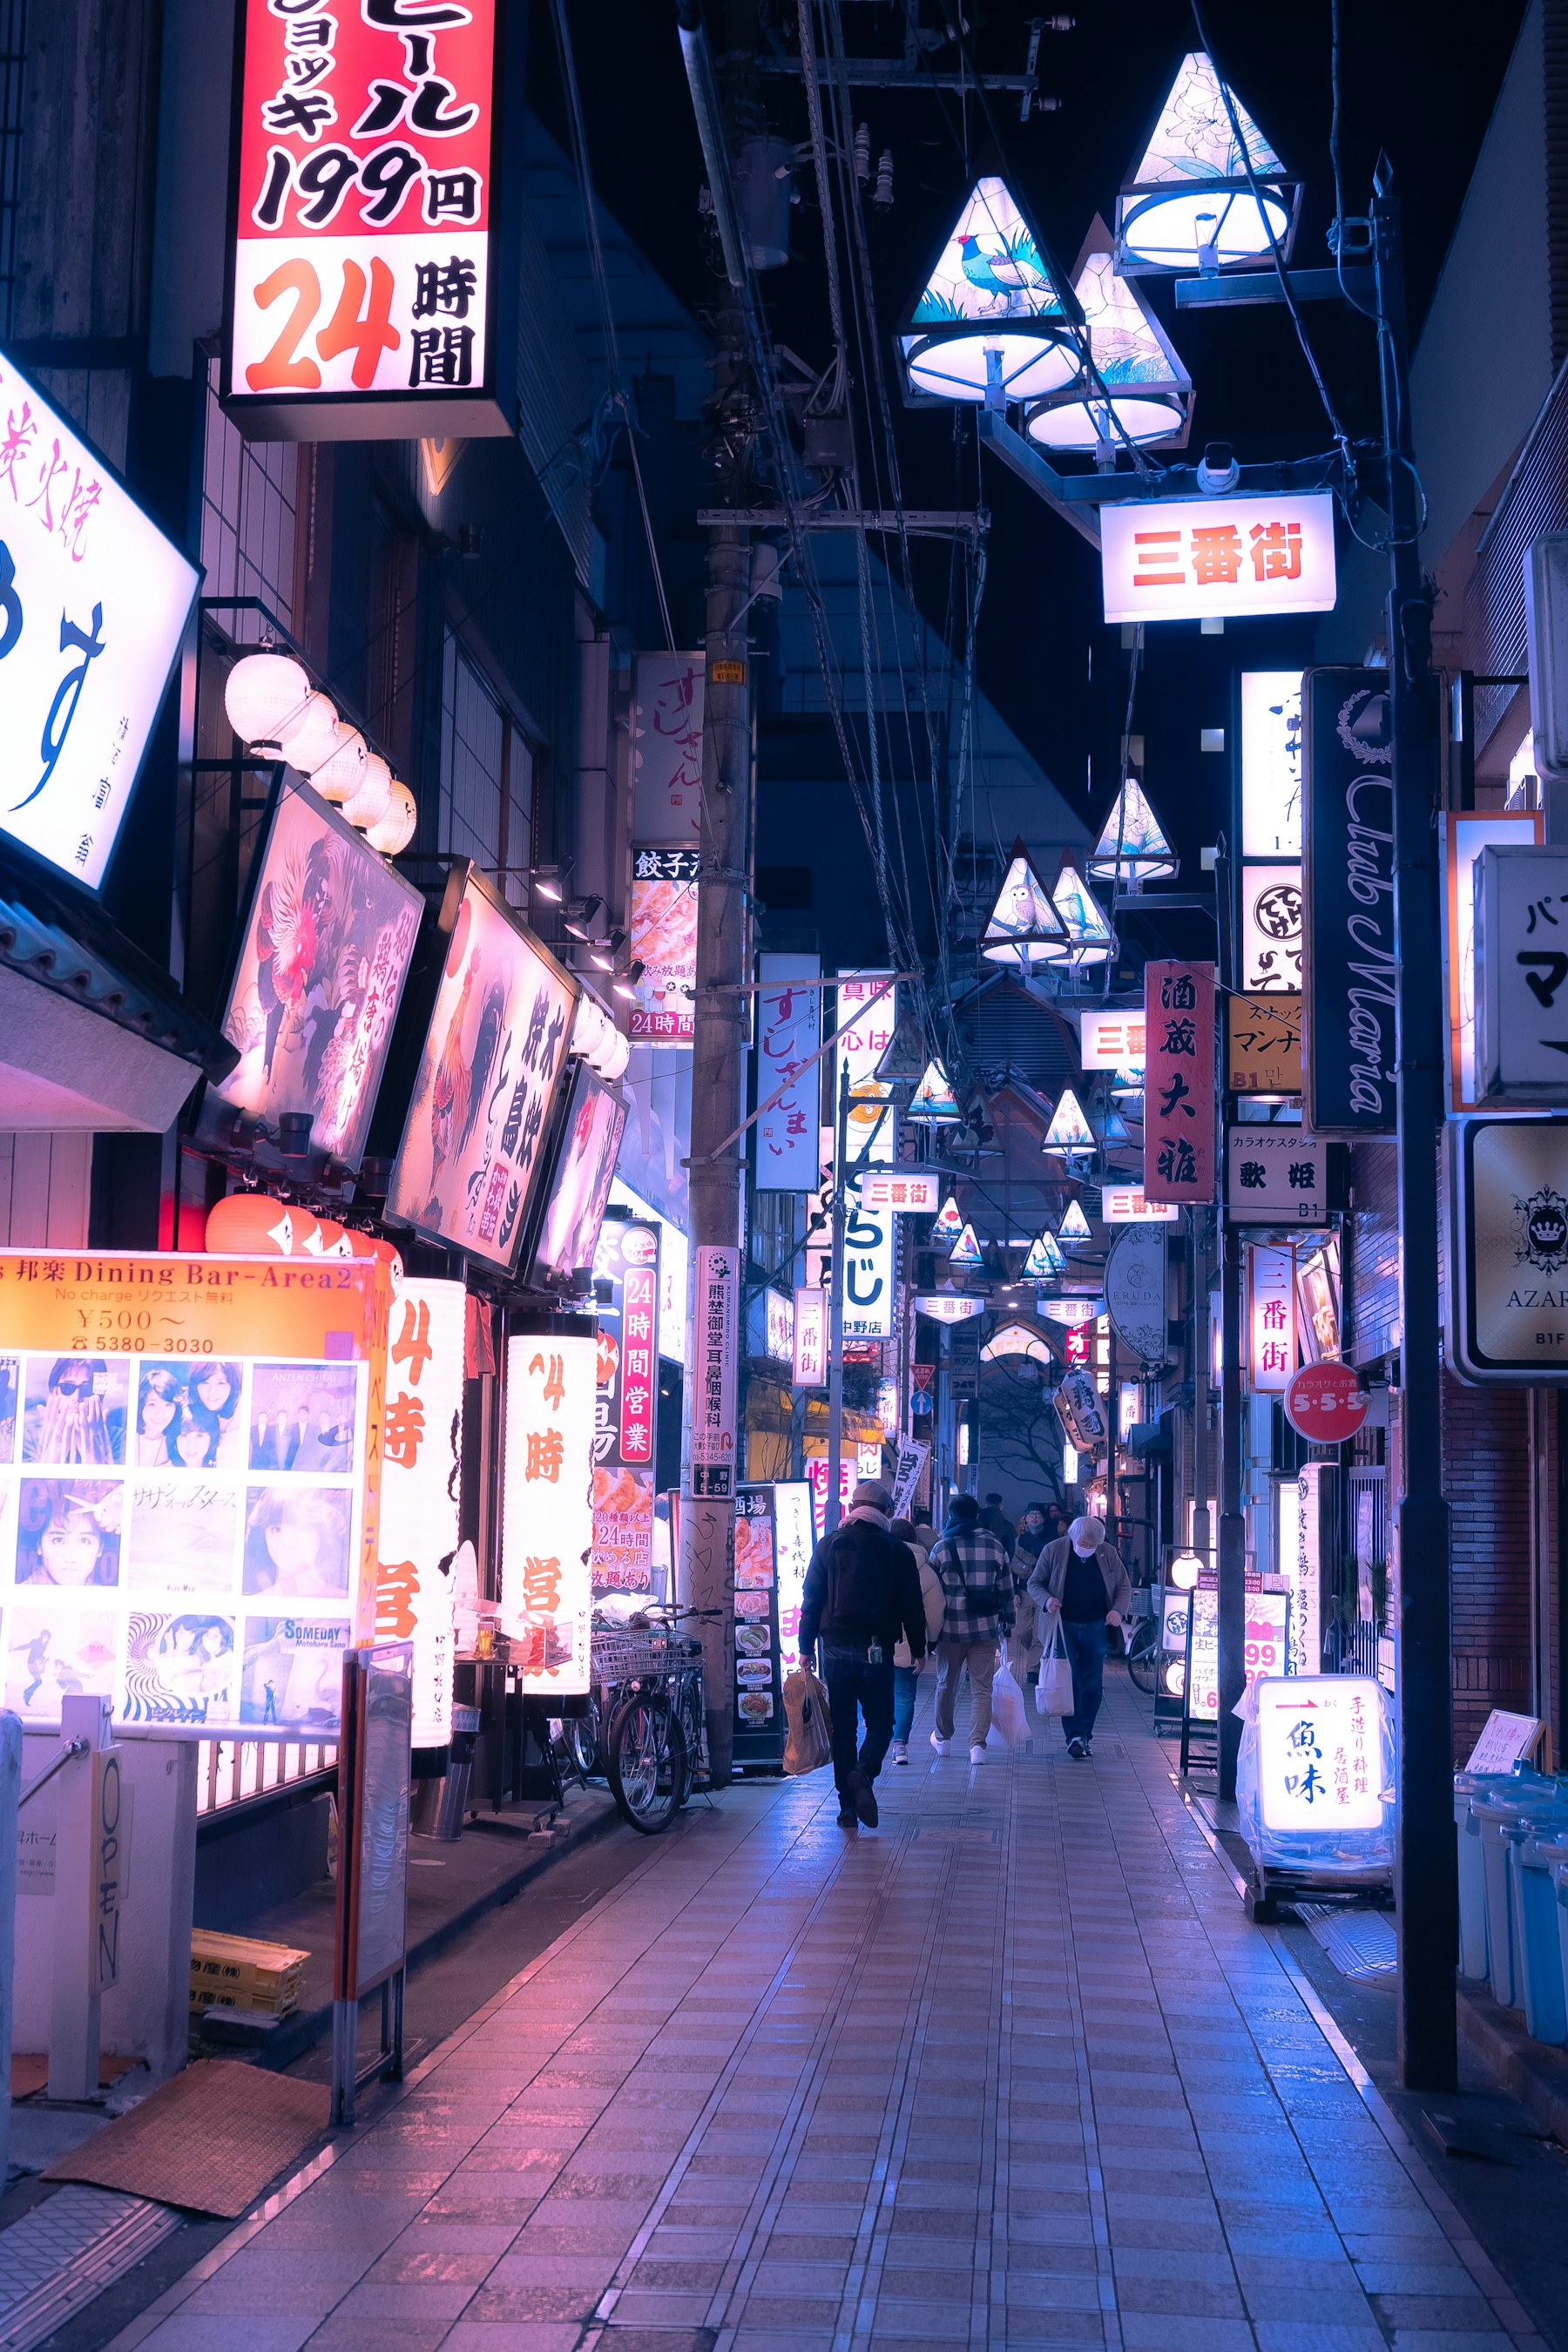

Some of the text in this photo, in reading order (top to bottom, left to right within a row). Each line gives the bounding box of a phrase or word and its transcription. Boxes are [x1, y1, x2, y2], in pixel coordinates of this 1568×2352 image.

[267, 0, 333, 137] ョッキ
[259, 146, 477, 225] 199円
[246, 256, 477, 392] 24 時間
[1133, 522, 1303, 587] 三番街
[1345, 775, 1394, 906] Club
[1526, 895, 1568, 933] パ
[1348, 914, 1396, 1115] Maria
[1233, 1031, 1301, 1053] マンナ
[762, 988, 808, 1156] すしざんまい
[1157, 976, 1199, 1186] 酒蔵大雅
[1233, 1071, 1259, 1088] B1
[1240, 1161, 1316, 1190] 歌姫
[871, 1183, 928, 1204] 三番街
[1299, 1203, 1318, 1217] B1
[17, 1260, 352, 1289] 邦楽 Dining Bar-Area2
[56, 1288, 234, 1305] No charge リクエスト無料
[927, 1300, 972, 1315] 三番街
[1049, 1303, 1094, 1317] 三番街
[1113, 1291, 1161, 1300] ERUDA
[1259, 1260, 1288, 1373] 三番街
[96, 1336, 214, 1353] 5380-3030
[801, 1301, 819, 1373] 三番街
[1536, 1333, 1565, 1344] B1F
[624, 1278, 652, 1452] 24時間営業
[704, 1284, 725, 1428] 熊埜御堂 耳鼻咽喉科
[272, 1373, 304, 1382] ANZEN
[1297, 1379, 1356, 1389] カラオケとお酒
[693, 1432, 720, 1442] この手前
[700, 1471, 728, 1482] 中野
[700, 1483, 728, 1492] 5-59
[592, 1512, 650, 1524] 120種類以上
[599, 1526, 649, 1547] 24時間
[285, 1619, 341, 1640] SOMEDAY
[1349, 1696, 1369, 1794] 手造り料理
[1284, 1720, 1327, 1804] 魚味
[1334, 1747, 1350, 1805] 居酒屋
[99, 1757, 121, 1984] OPEN
